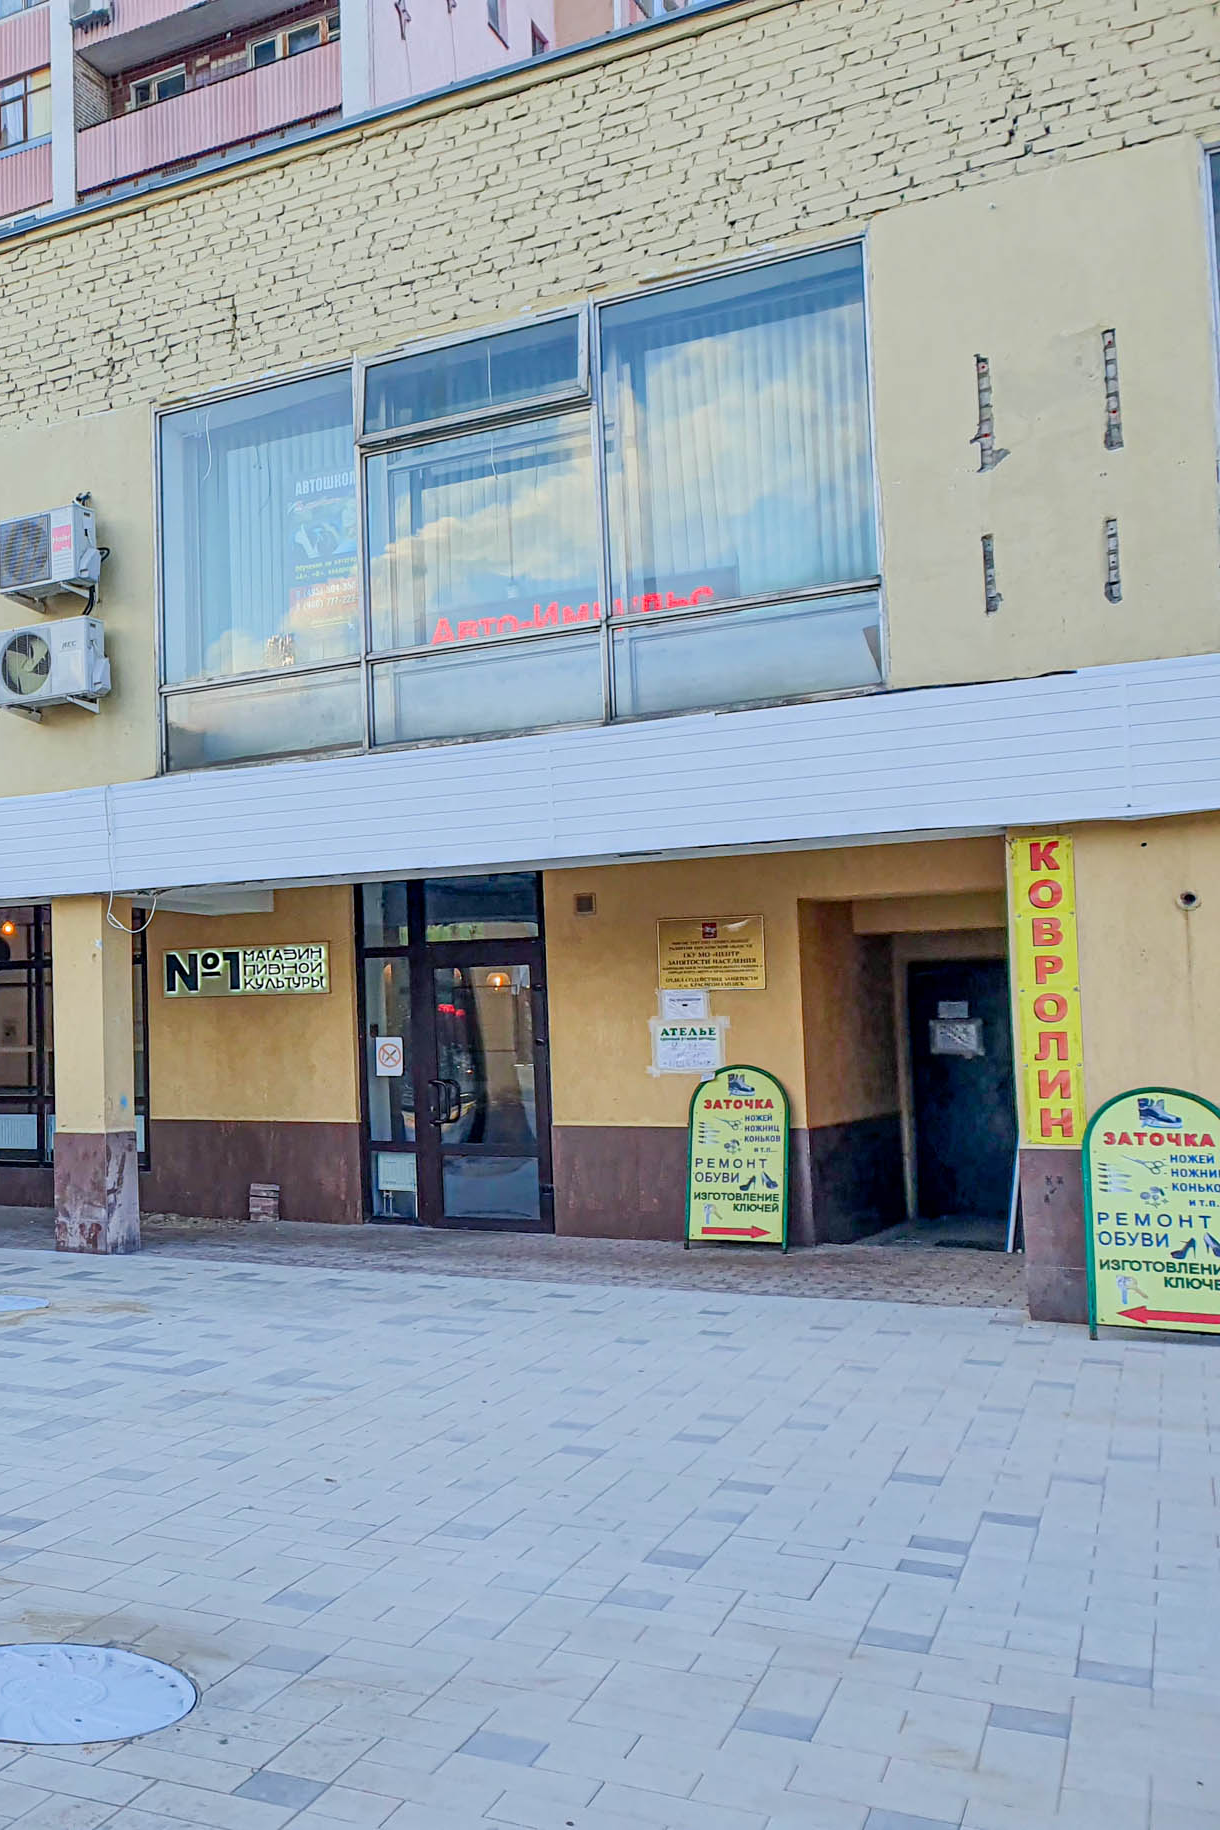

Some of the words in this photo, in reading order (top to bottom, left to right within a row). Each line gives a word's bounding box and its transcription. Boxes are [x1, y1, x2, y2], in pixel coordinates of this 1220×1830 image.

[295, 471, 356, 496] АВТОШКОЛ
[244, 948, 322, 961] МАГАЗИН
[244, 960, 322, 976] ПИВНОЙ
[244, 976, 324, 989] КУЛЬТУРЫ
[1028, 840, 1074, 1138] КОВРОЛИН
[660, 1027, 717, 1036] АТЕЛЬЕ
[703, 1099, 774, 1110] ЗАТОЧКА
[744, 1113, 773, 1122] НОЖЕЙ
[744, 1125, 780, 1133] НОЖНИЦ
[744, 1135, 781, 1143] КОНЬКОВ
[1103, 1131, 1216, 1148] ЗАТОЧКА
[695, 1158, 767, 1169] РЕМОНТ
[1170, 1153, 1215, 1165] НОЖЕЙ
[694, 1171, 740, 1183] ОБУВИ
[1171, 1168, 1220, 1178] НОЖНИ
[1172, 1182, 1220, 1193] КОНЬКО
[694, 1191, 780, 1202] ИЗГОТОВЛЕНИЕ
[733, 1202, 779, 1213] КЛЮЧЕЙ
[1097, 1212, 1212, 1229] РЕМОНТ
[1098, 1231, 1169, 1249] ОБУВИ
[1099, 1259, 1220, 1276] ИЗГОТОВЛЕНИ
[1164, 1276, 1220, 1291] КЛЮЧЕ
